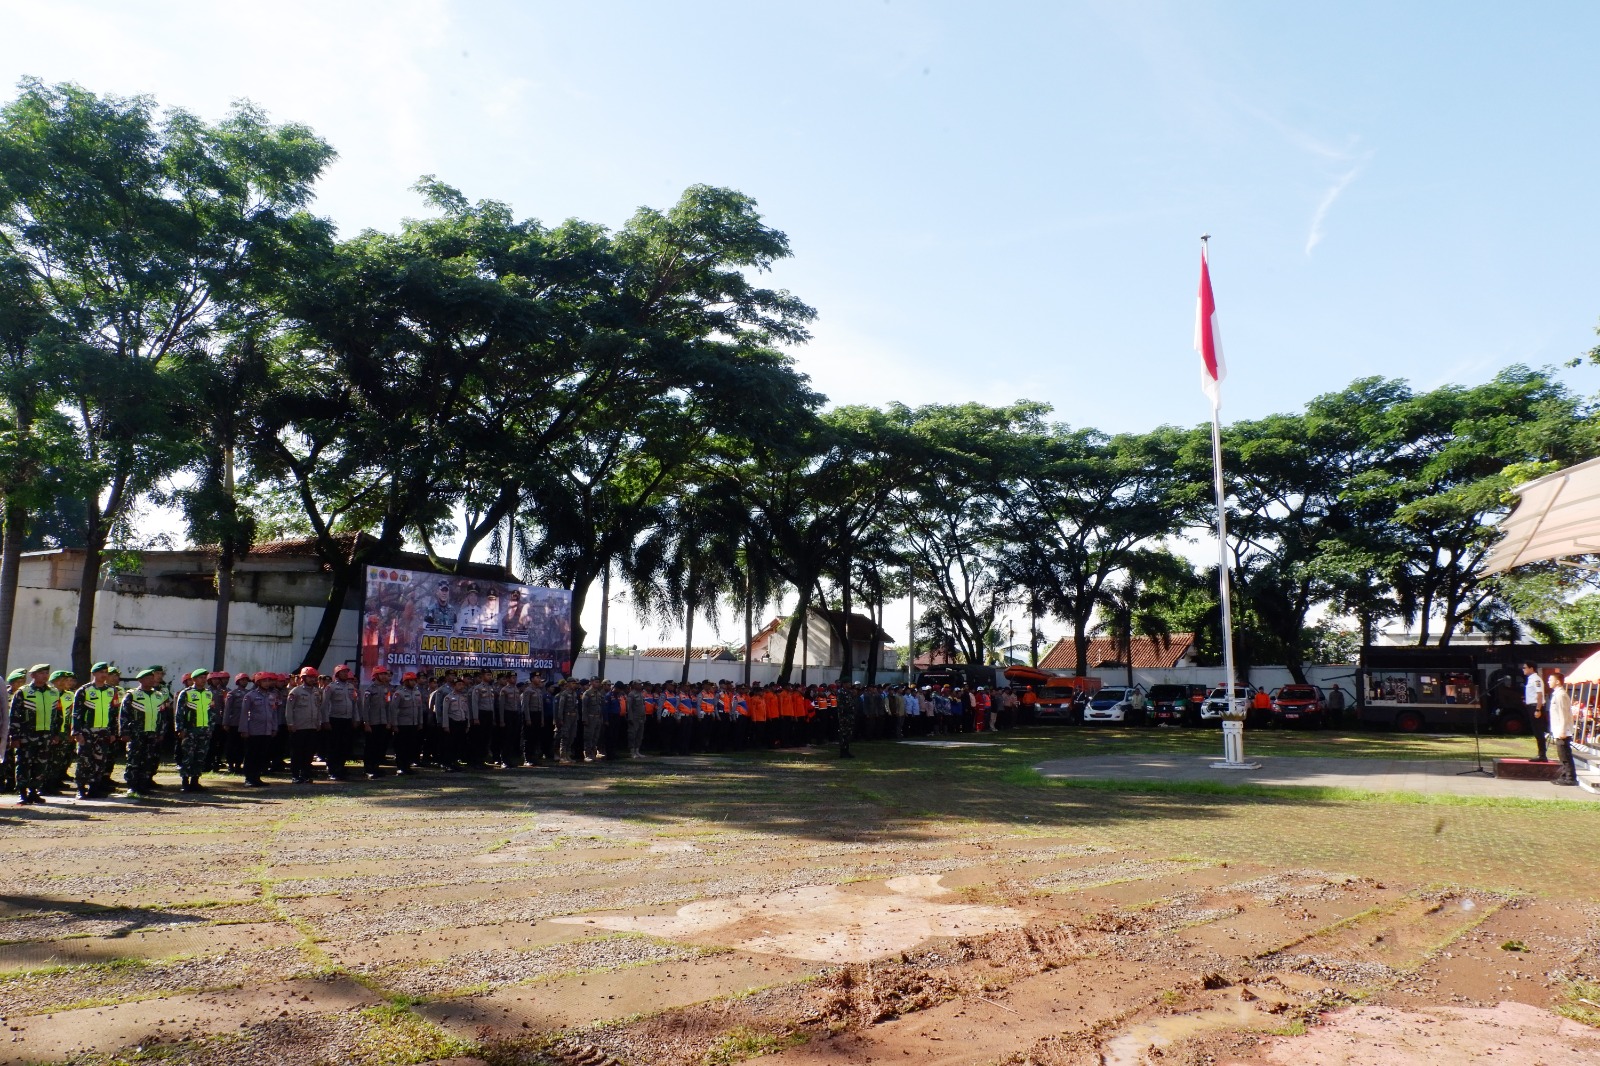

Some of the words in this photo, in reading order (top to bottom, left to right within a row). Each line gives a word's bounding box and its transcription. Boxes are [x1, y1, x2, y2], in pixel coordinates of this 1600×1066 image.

[421, 635, 448, 651] APEL
[449, 637, 482, 653] GELAR
[484, 639, 529, 655] PASUKAN
[387, 653, 417, 665] SIAGA
[419, 654, 462, 666] TANGGAP
[463, 656, 503, 667] BENCANA
[504, 657, 532, 668] TAHUN
[533, 659, 553, 669] 2025
